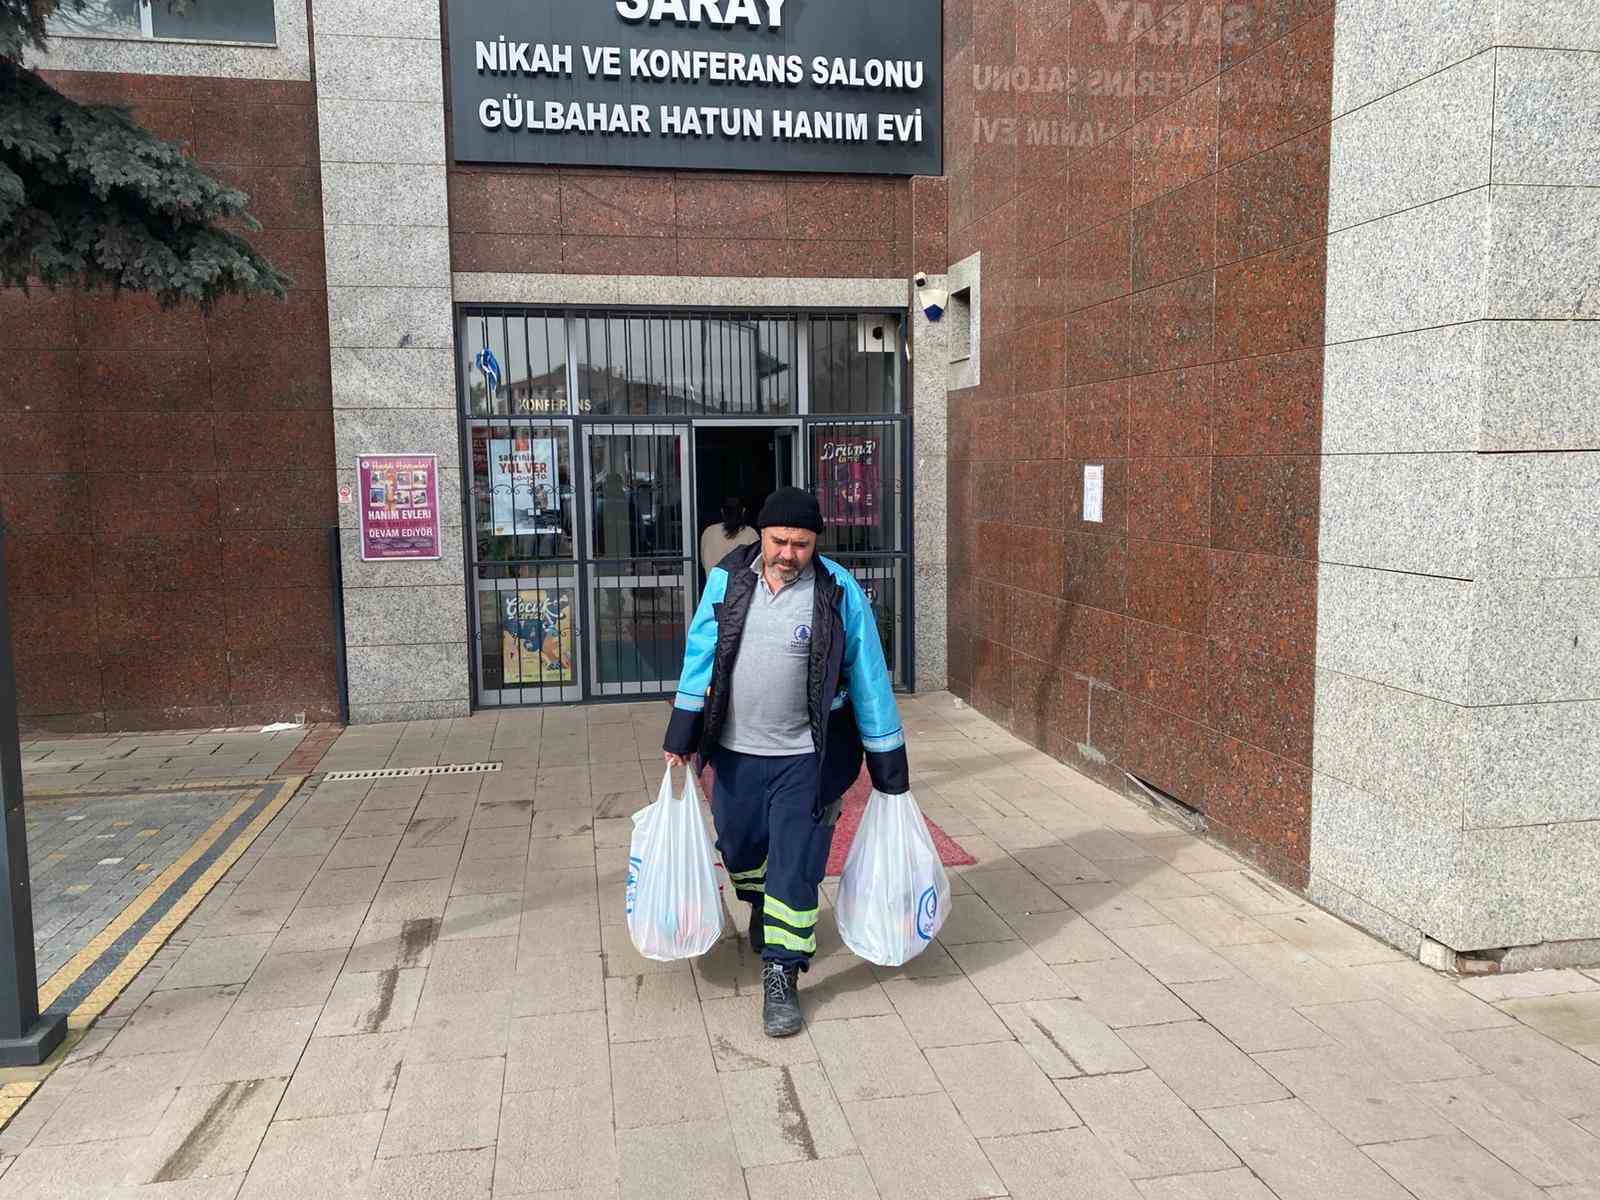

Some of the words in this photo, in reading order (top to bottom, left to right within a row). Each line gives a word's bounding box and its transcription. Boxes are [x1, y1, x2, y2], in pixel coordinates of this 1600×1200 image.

[475, 35, 573, 74] NİKAH
[582, 45, 621, 76] VE
[630, 48, 804, 83] KONFERANS
[811, 56, 924, 88] SALONU
[478, 93, 651, 133] GÜLBAHAR
[660, 105, 763, 137] HATUN
[772, 110, 868, 140] HANIM
[878, 108, 923, 142] EVİ
[520, 399, 592, 411] KONFERNS
[499, 462, 522, 474] YOL
[525, 462, 548, 474] VER
[368, 510, 400, 520] HANIM
[369, 528, 399, 538] DEVAM
[401, 527, 433, 537] EDİYOR
